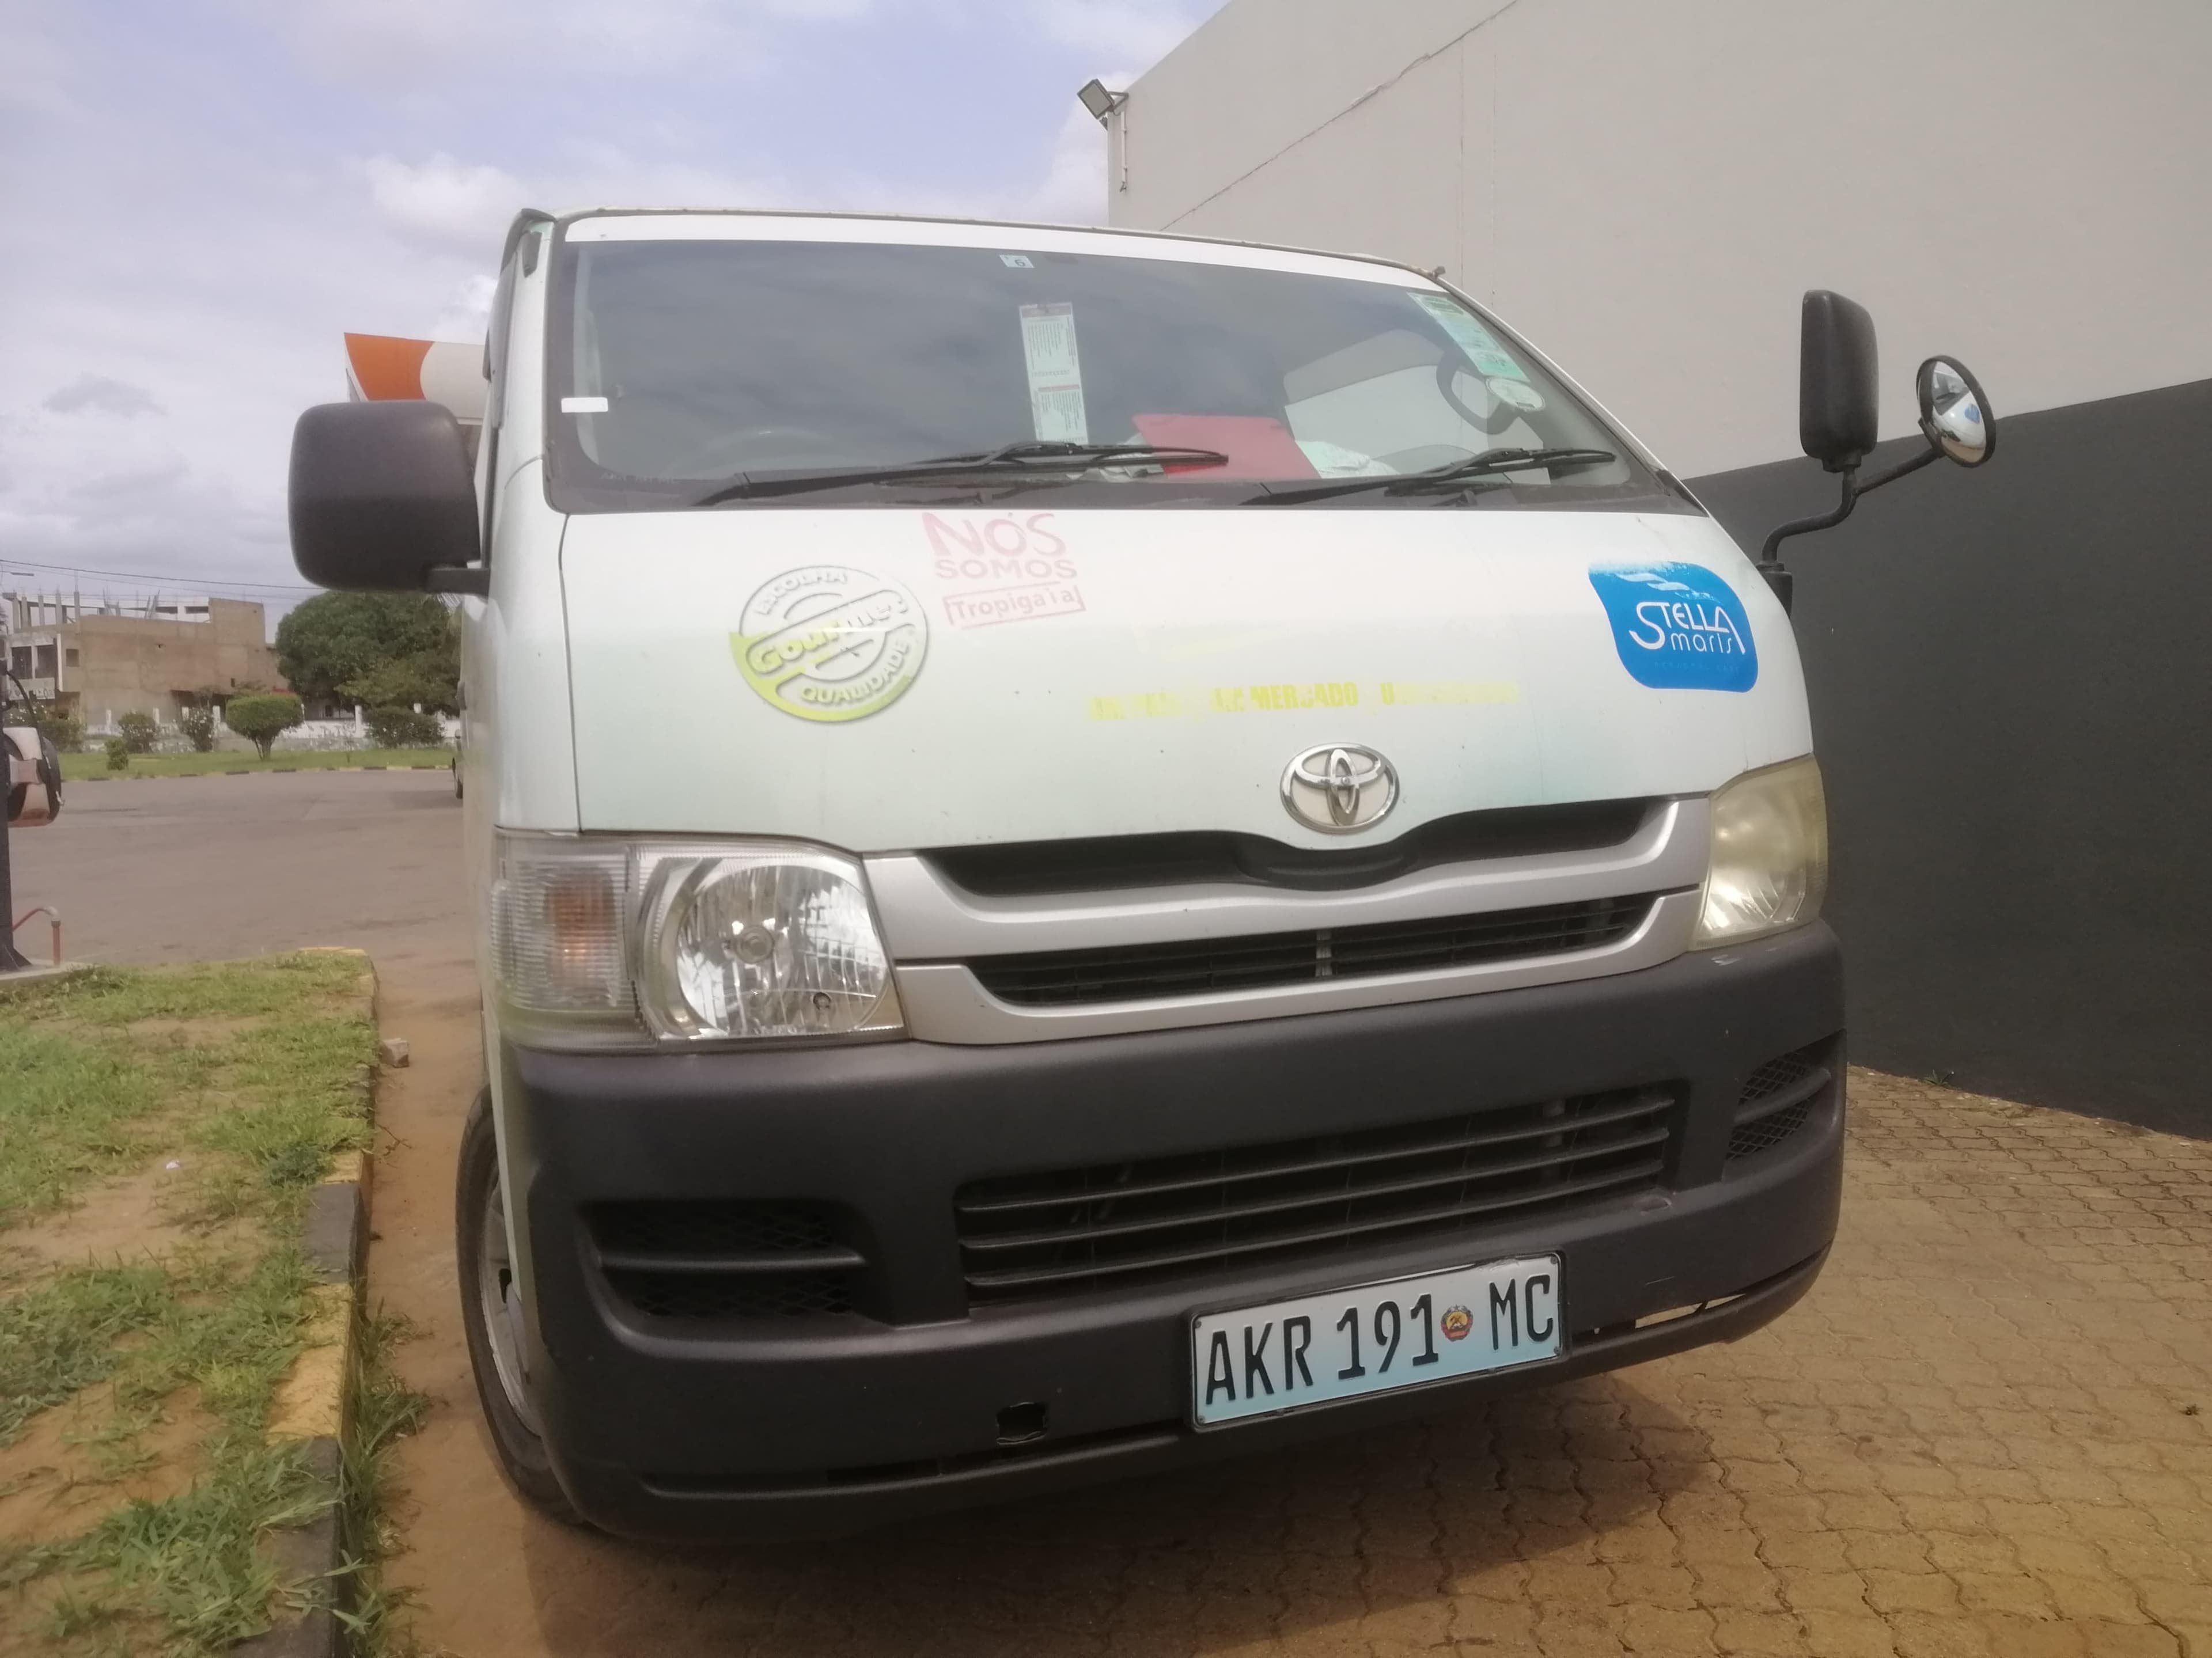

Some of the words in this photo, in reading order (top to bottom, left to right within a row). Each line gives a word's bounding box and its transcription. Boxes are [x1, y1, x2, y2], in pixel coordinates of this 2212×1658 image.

[934, 559, 1078, 579] SOMOS
[800, 639, 911, 705] QUALIDADE
[1205, 1315, 1314, 1405] AKR
[1336, 1293, 1439, 1380] 191
[1488, 1274, 1554, 1351] MC
